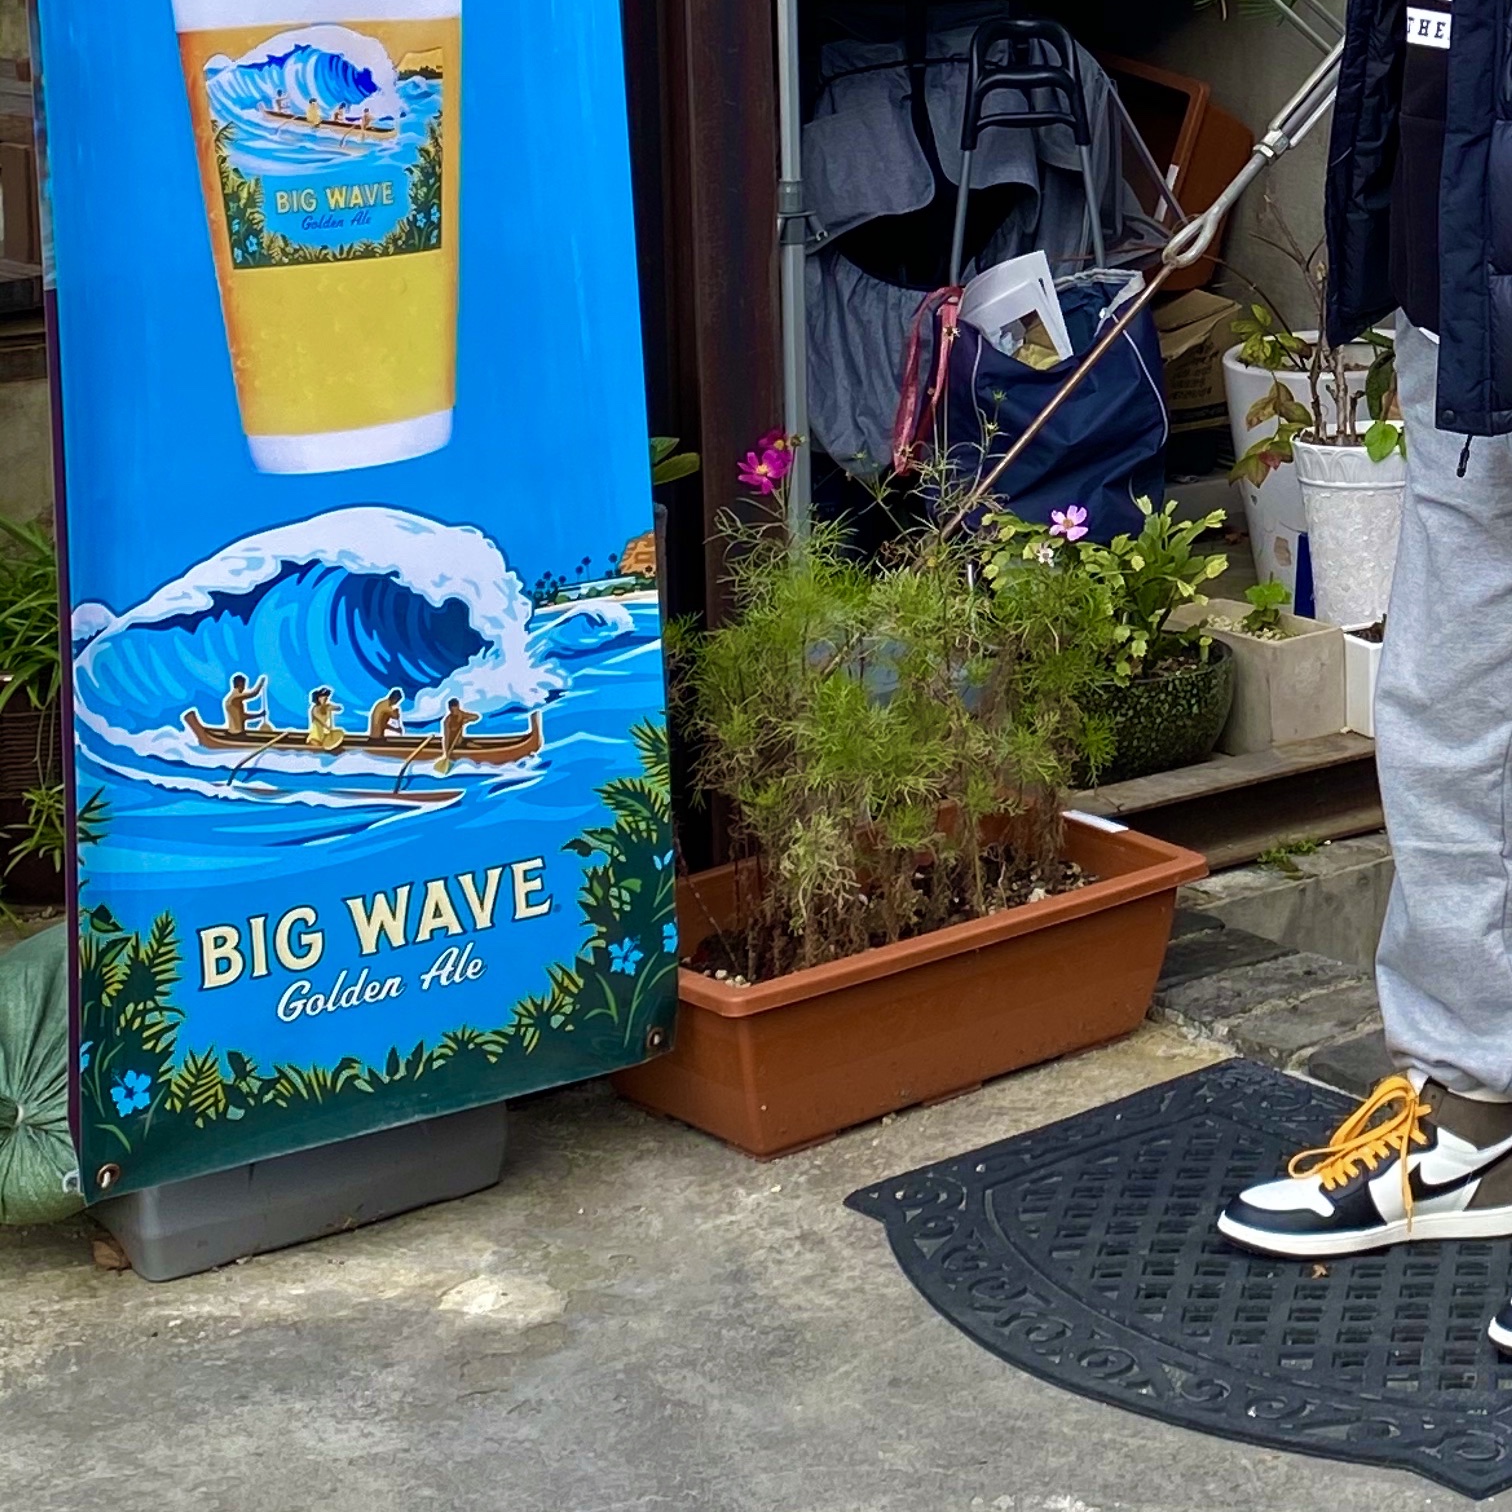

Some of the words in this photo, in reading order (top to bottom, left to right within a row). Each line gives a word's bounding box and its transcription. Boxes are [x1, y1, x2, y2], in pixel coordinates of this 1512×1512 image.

[275, 188, 318, 214] BIG
[324, 181, 394, 211] WAVE
[301, 215, 345, 231] Golden
[350, 210, 372, 227] Ale
[199, 905, 325, 991] BIG
[343, 857, 553, 957] WAVE
[277, 974, 406, 1024] Golden
[421, 945, 486, 992] Ale
